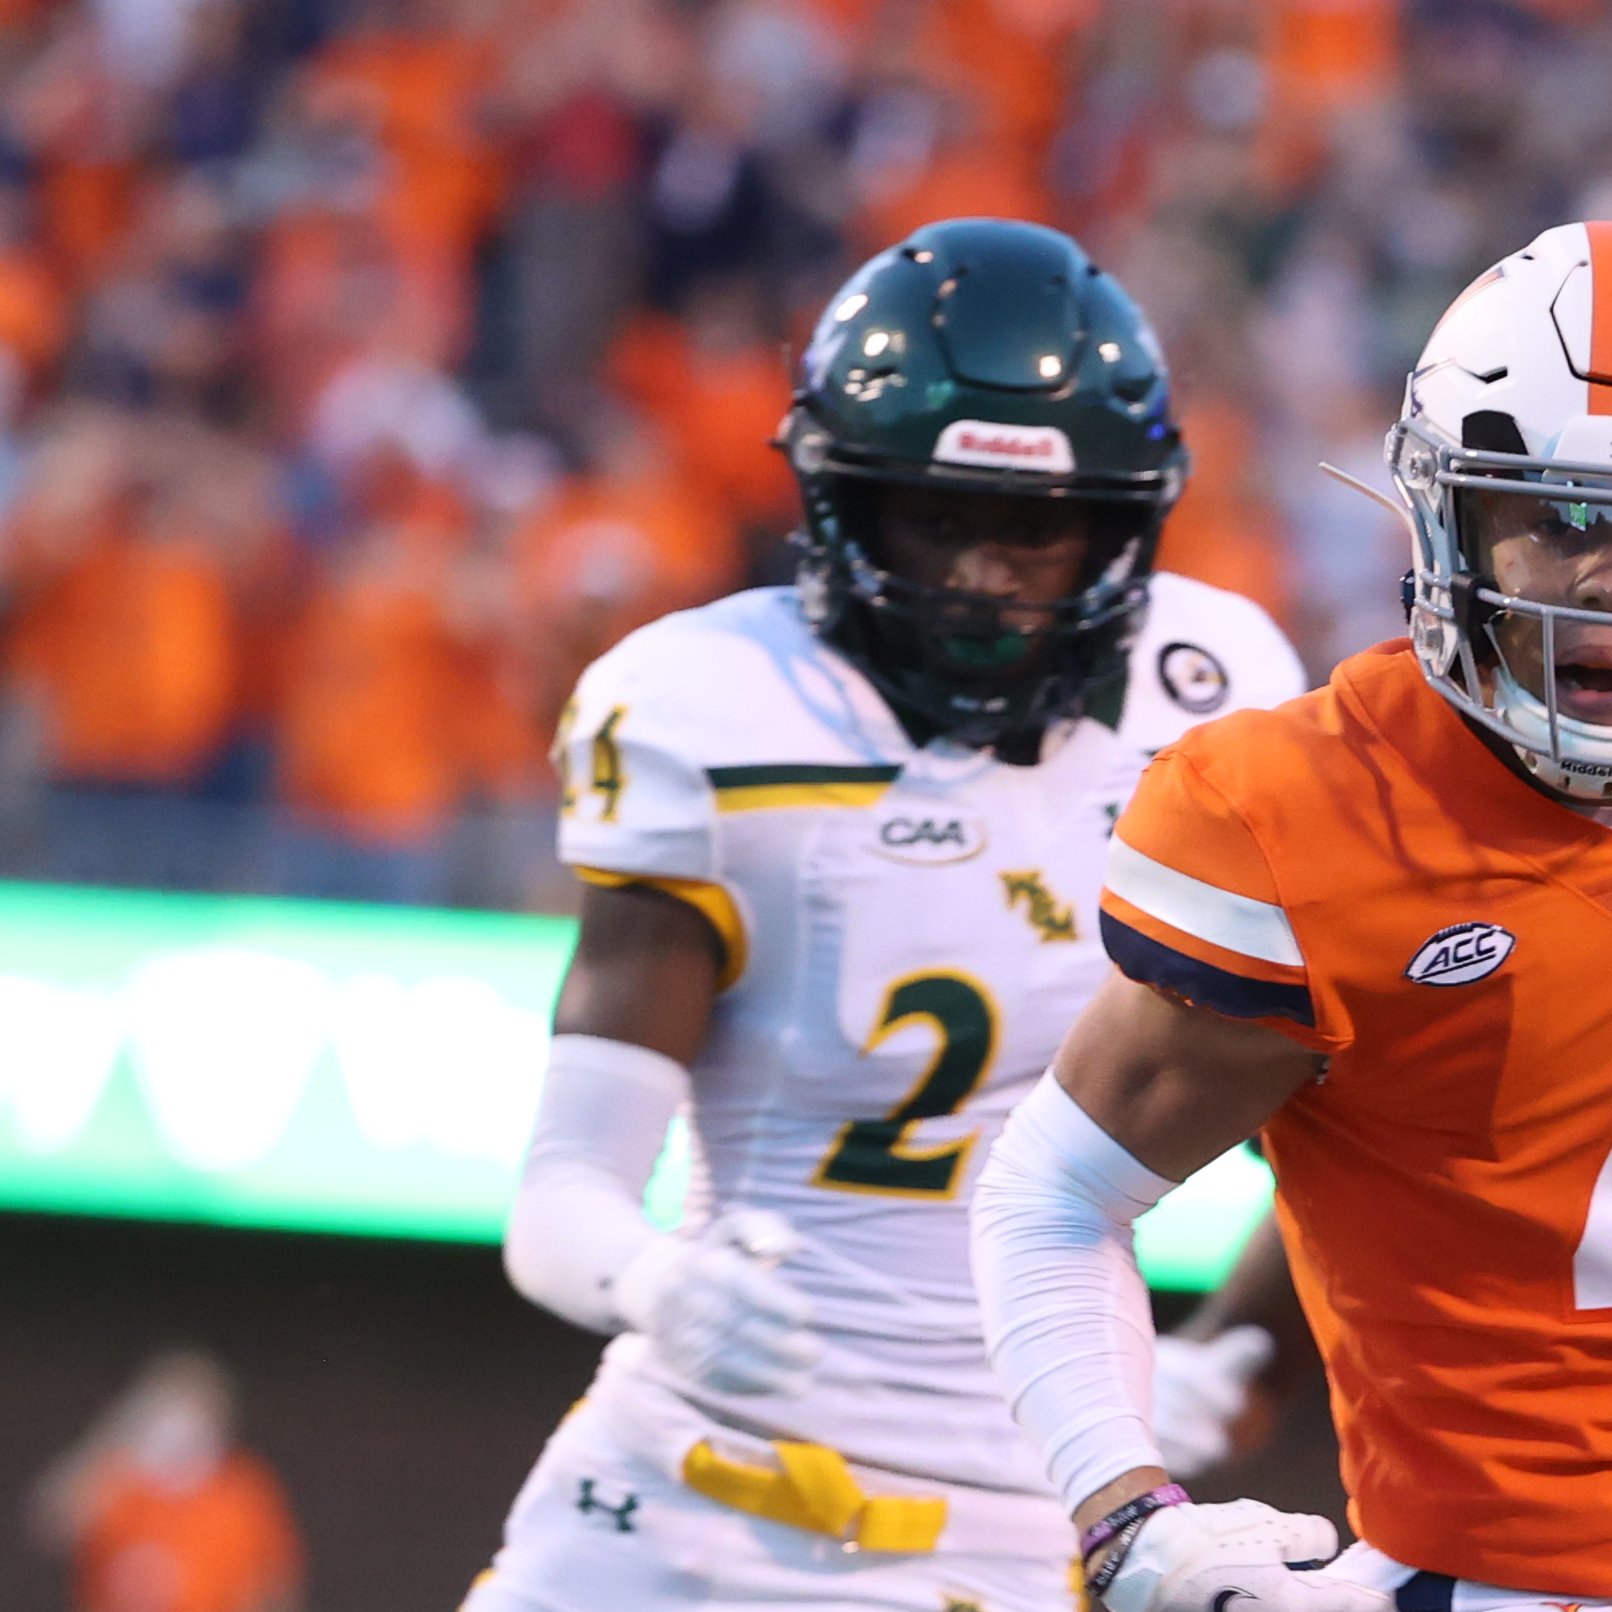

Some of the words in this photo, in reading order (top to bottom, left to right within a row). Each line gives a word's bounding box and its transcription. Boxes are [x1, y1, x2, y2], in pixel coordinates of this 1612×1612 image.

[555, 695, 632, 823] 4
[880, 817, 966, 846] CAA
[1420, 929, 1497, 974] ACC
[808, 967, 1004, 1201] 2
